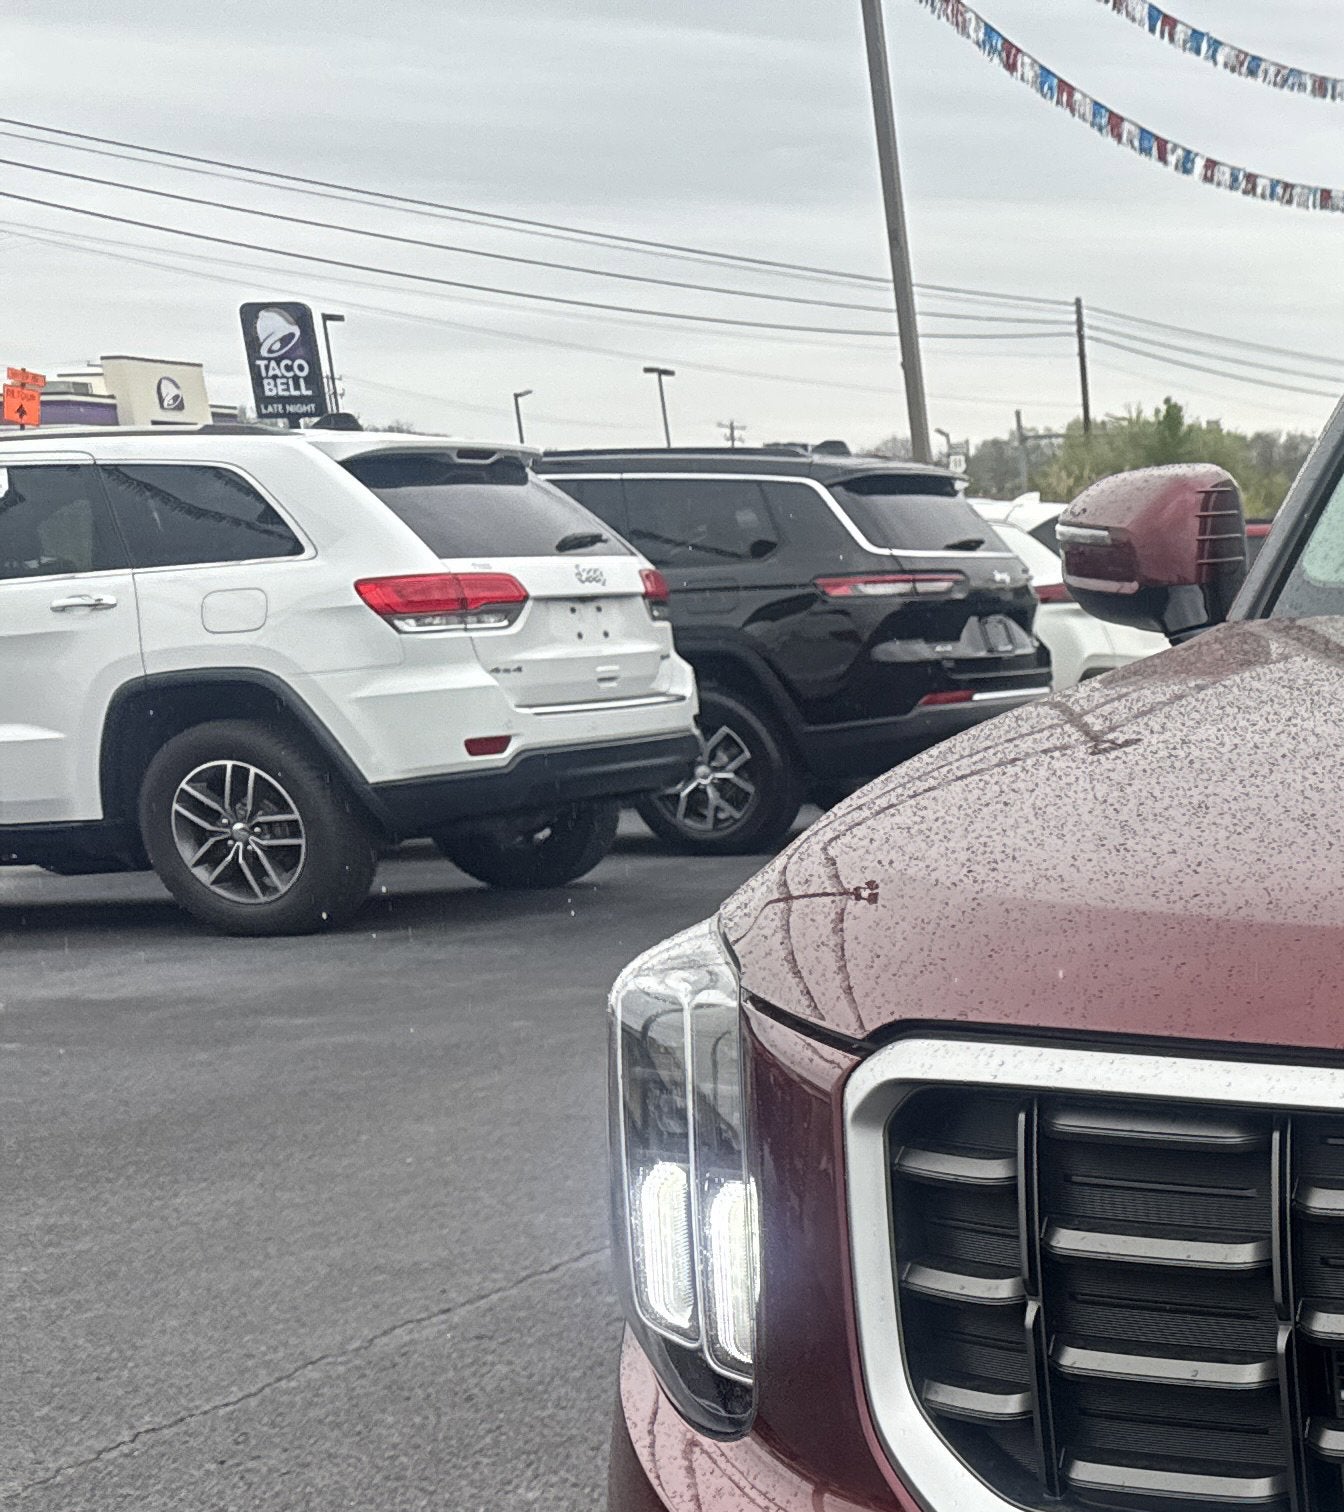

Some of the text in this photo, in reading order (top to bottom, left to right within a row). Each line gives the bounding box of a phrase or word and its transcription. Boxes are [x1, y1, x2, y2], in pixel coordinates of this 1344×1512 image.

[255, 358, 310, 378] TACO
[262, 377, 313, 396] BELL
[260, 403, 316, 414] LATE NIGHT
